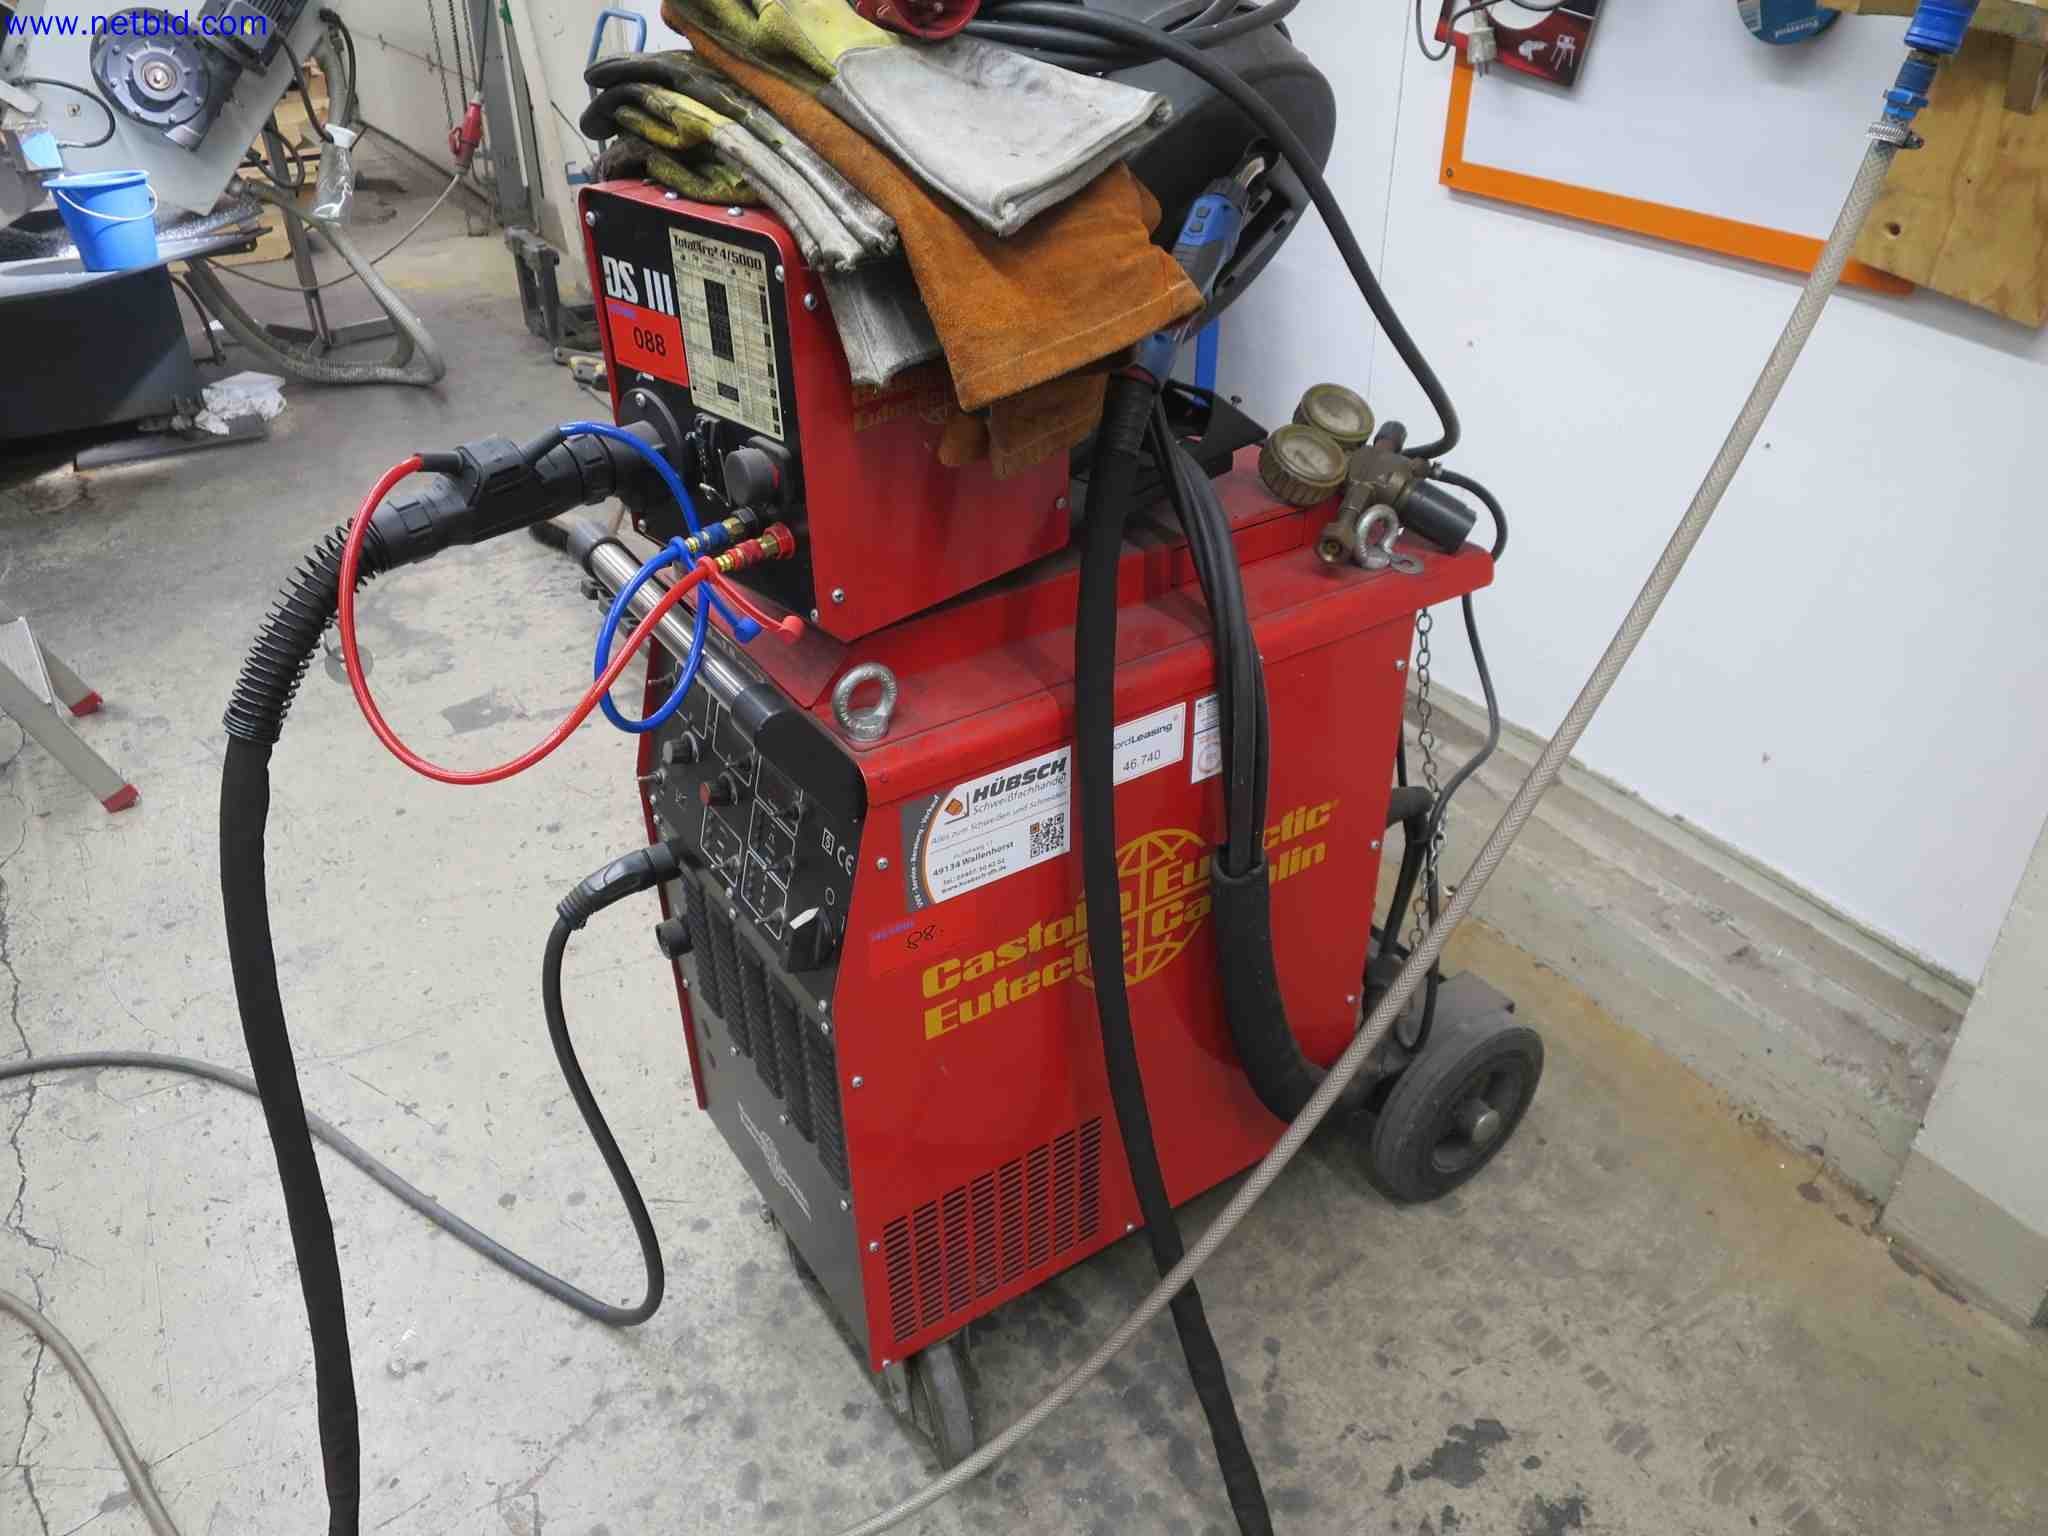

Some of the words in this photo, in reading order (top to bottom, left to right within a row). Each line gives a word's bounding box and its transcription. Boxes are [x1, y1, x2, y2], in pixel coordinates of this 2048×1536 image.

[602, 254, 638, 304] DS
[633, 326, 667, 357] 088
[1113, 722, 1173, 751] ordLeasing
[972, 756, 1067, 803] HÜBSCH
